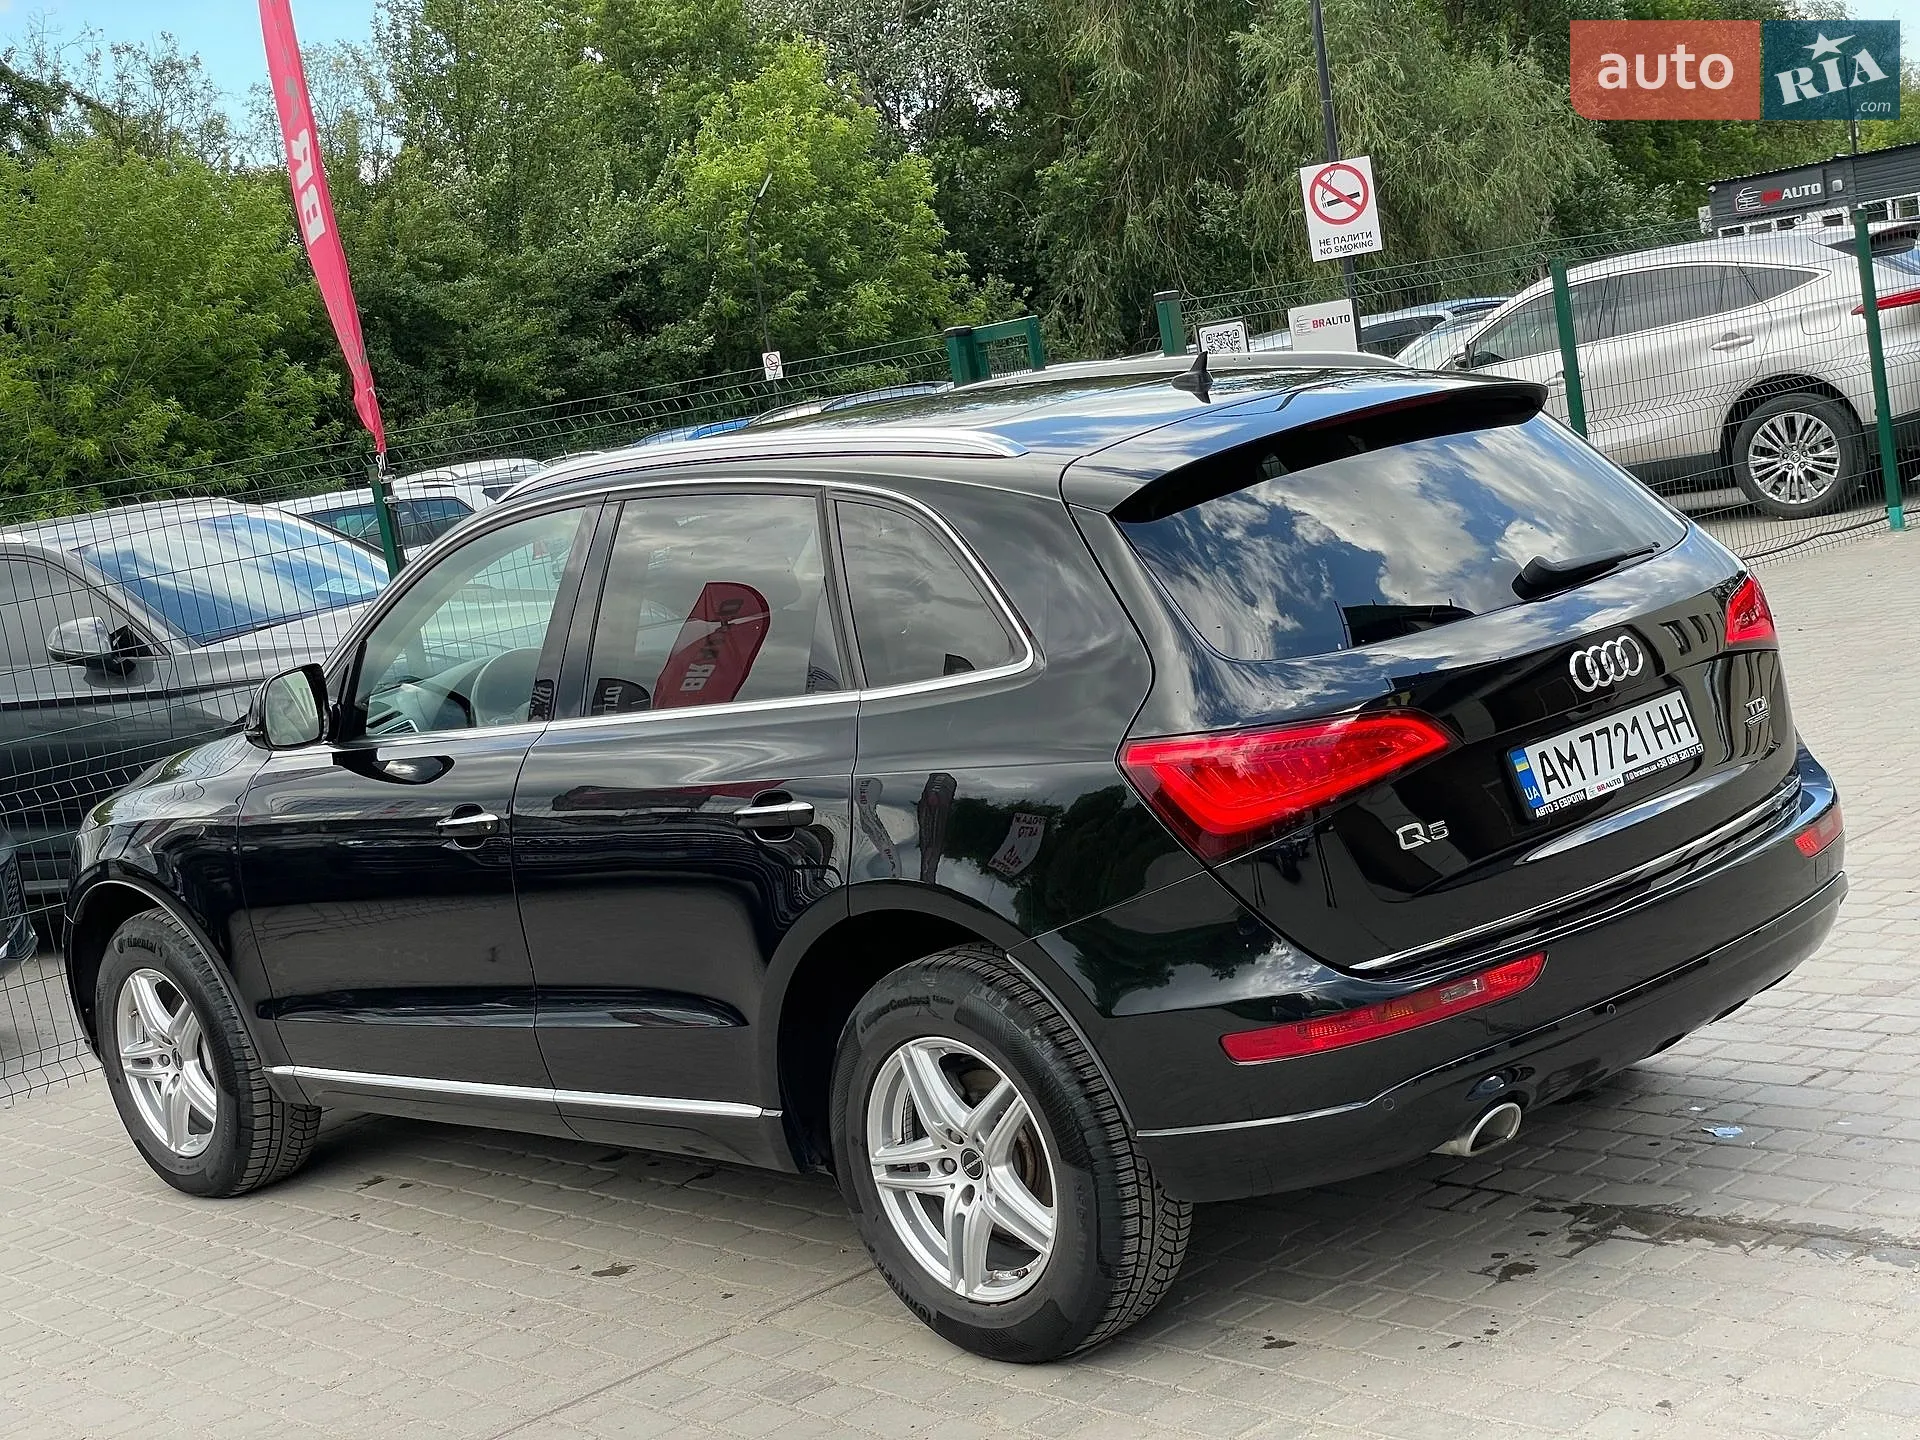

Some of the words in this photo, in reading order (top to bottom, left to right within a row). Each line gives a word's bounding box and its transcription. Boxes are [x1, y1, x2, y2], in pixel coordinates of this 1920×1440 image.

[1761, 183, 1822, 203] AUTO
[1319, 238, 1332, 247] НЕ
[1333, 230, 1373, 245] ПАЛИТИ
[1320, 247, 1333, 256] NO
[1334, 239, 1374, 253] SMOKING
[1311, 314, 1351, 329] BRAUTO
[1745, 695, 1768, 716] TDI
[1596, 777, 1622, 792] BRAUTO
[1524, 786, 1541, 801] UA
[1396, 820, 1449, 850] Q5
